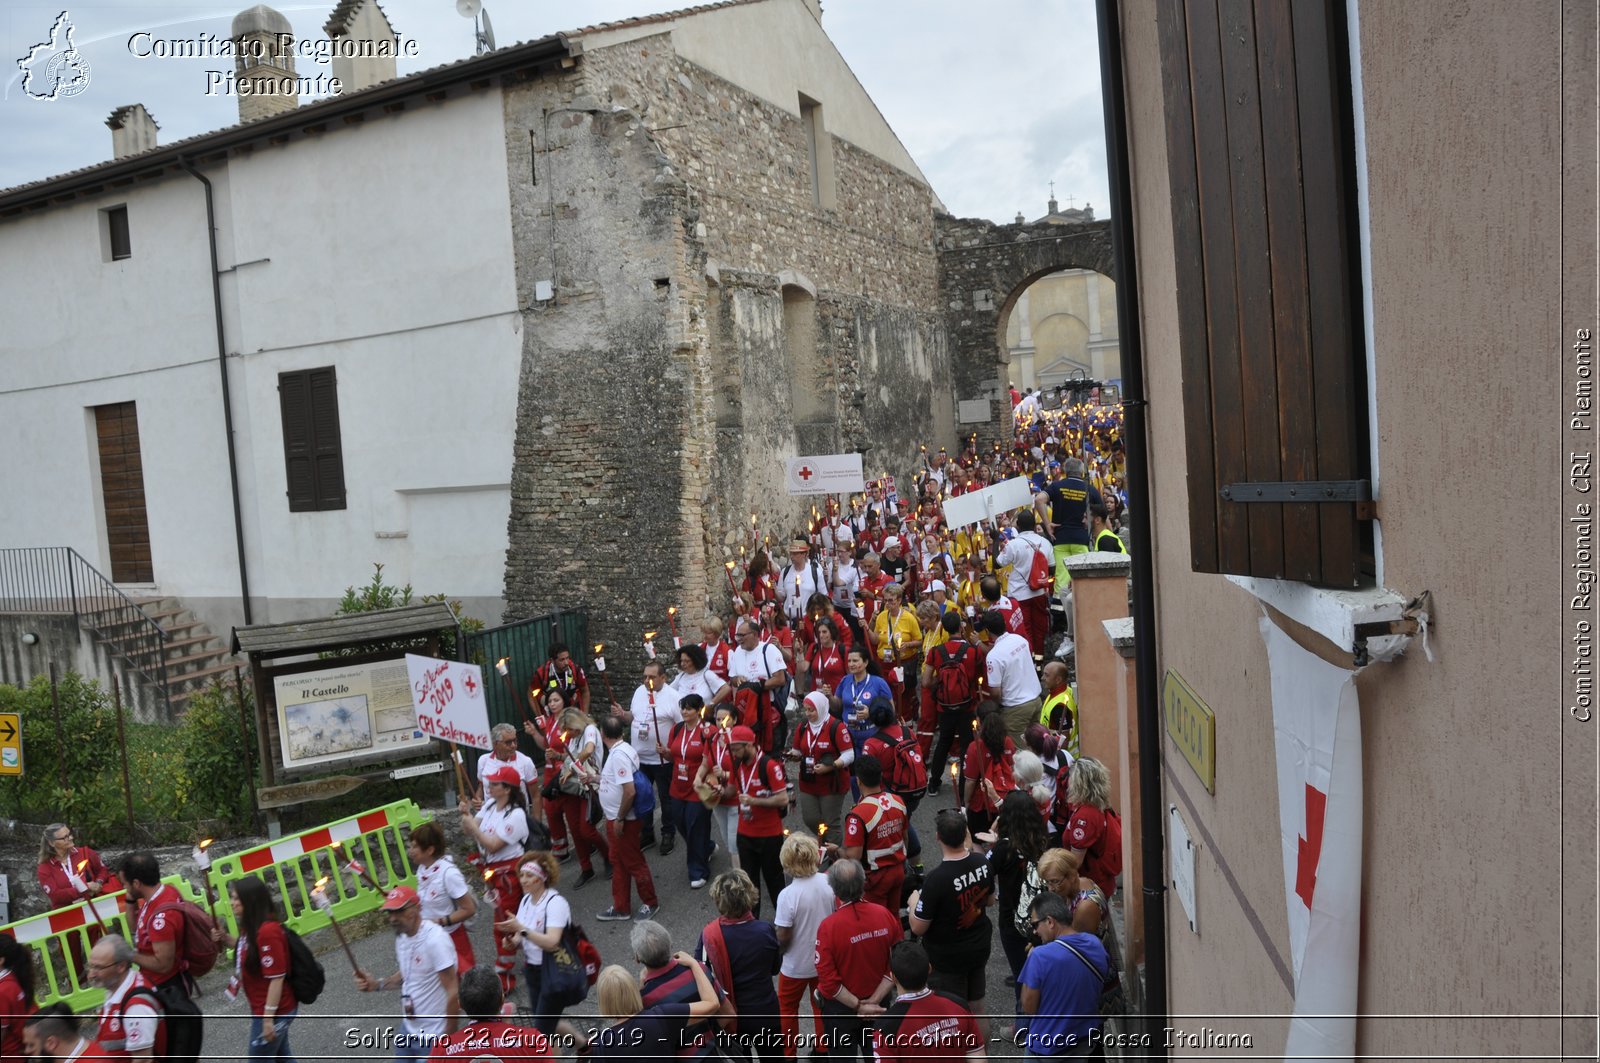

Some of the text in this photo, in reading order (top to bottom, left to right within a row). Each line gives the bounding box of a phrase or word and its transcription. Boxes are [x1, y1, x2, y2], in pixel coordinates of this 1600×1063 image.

[302, 685, 349, 699] Il Castello
[430, 678, 454, 715] 2019
[418, 714, 436, 736] CRI
[1171, 687, 1204, 766] ROCCA
[953, 864, 988, 891] STAFF
